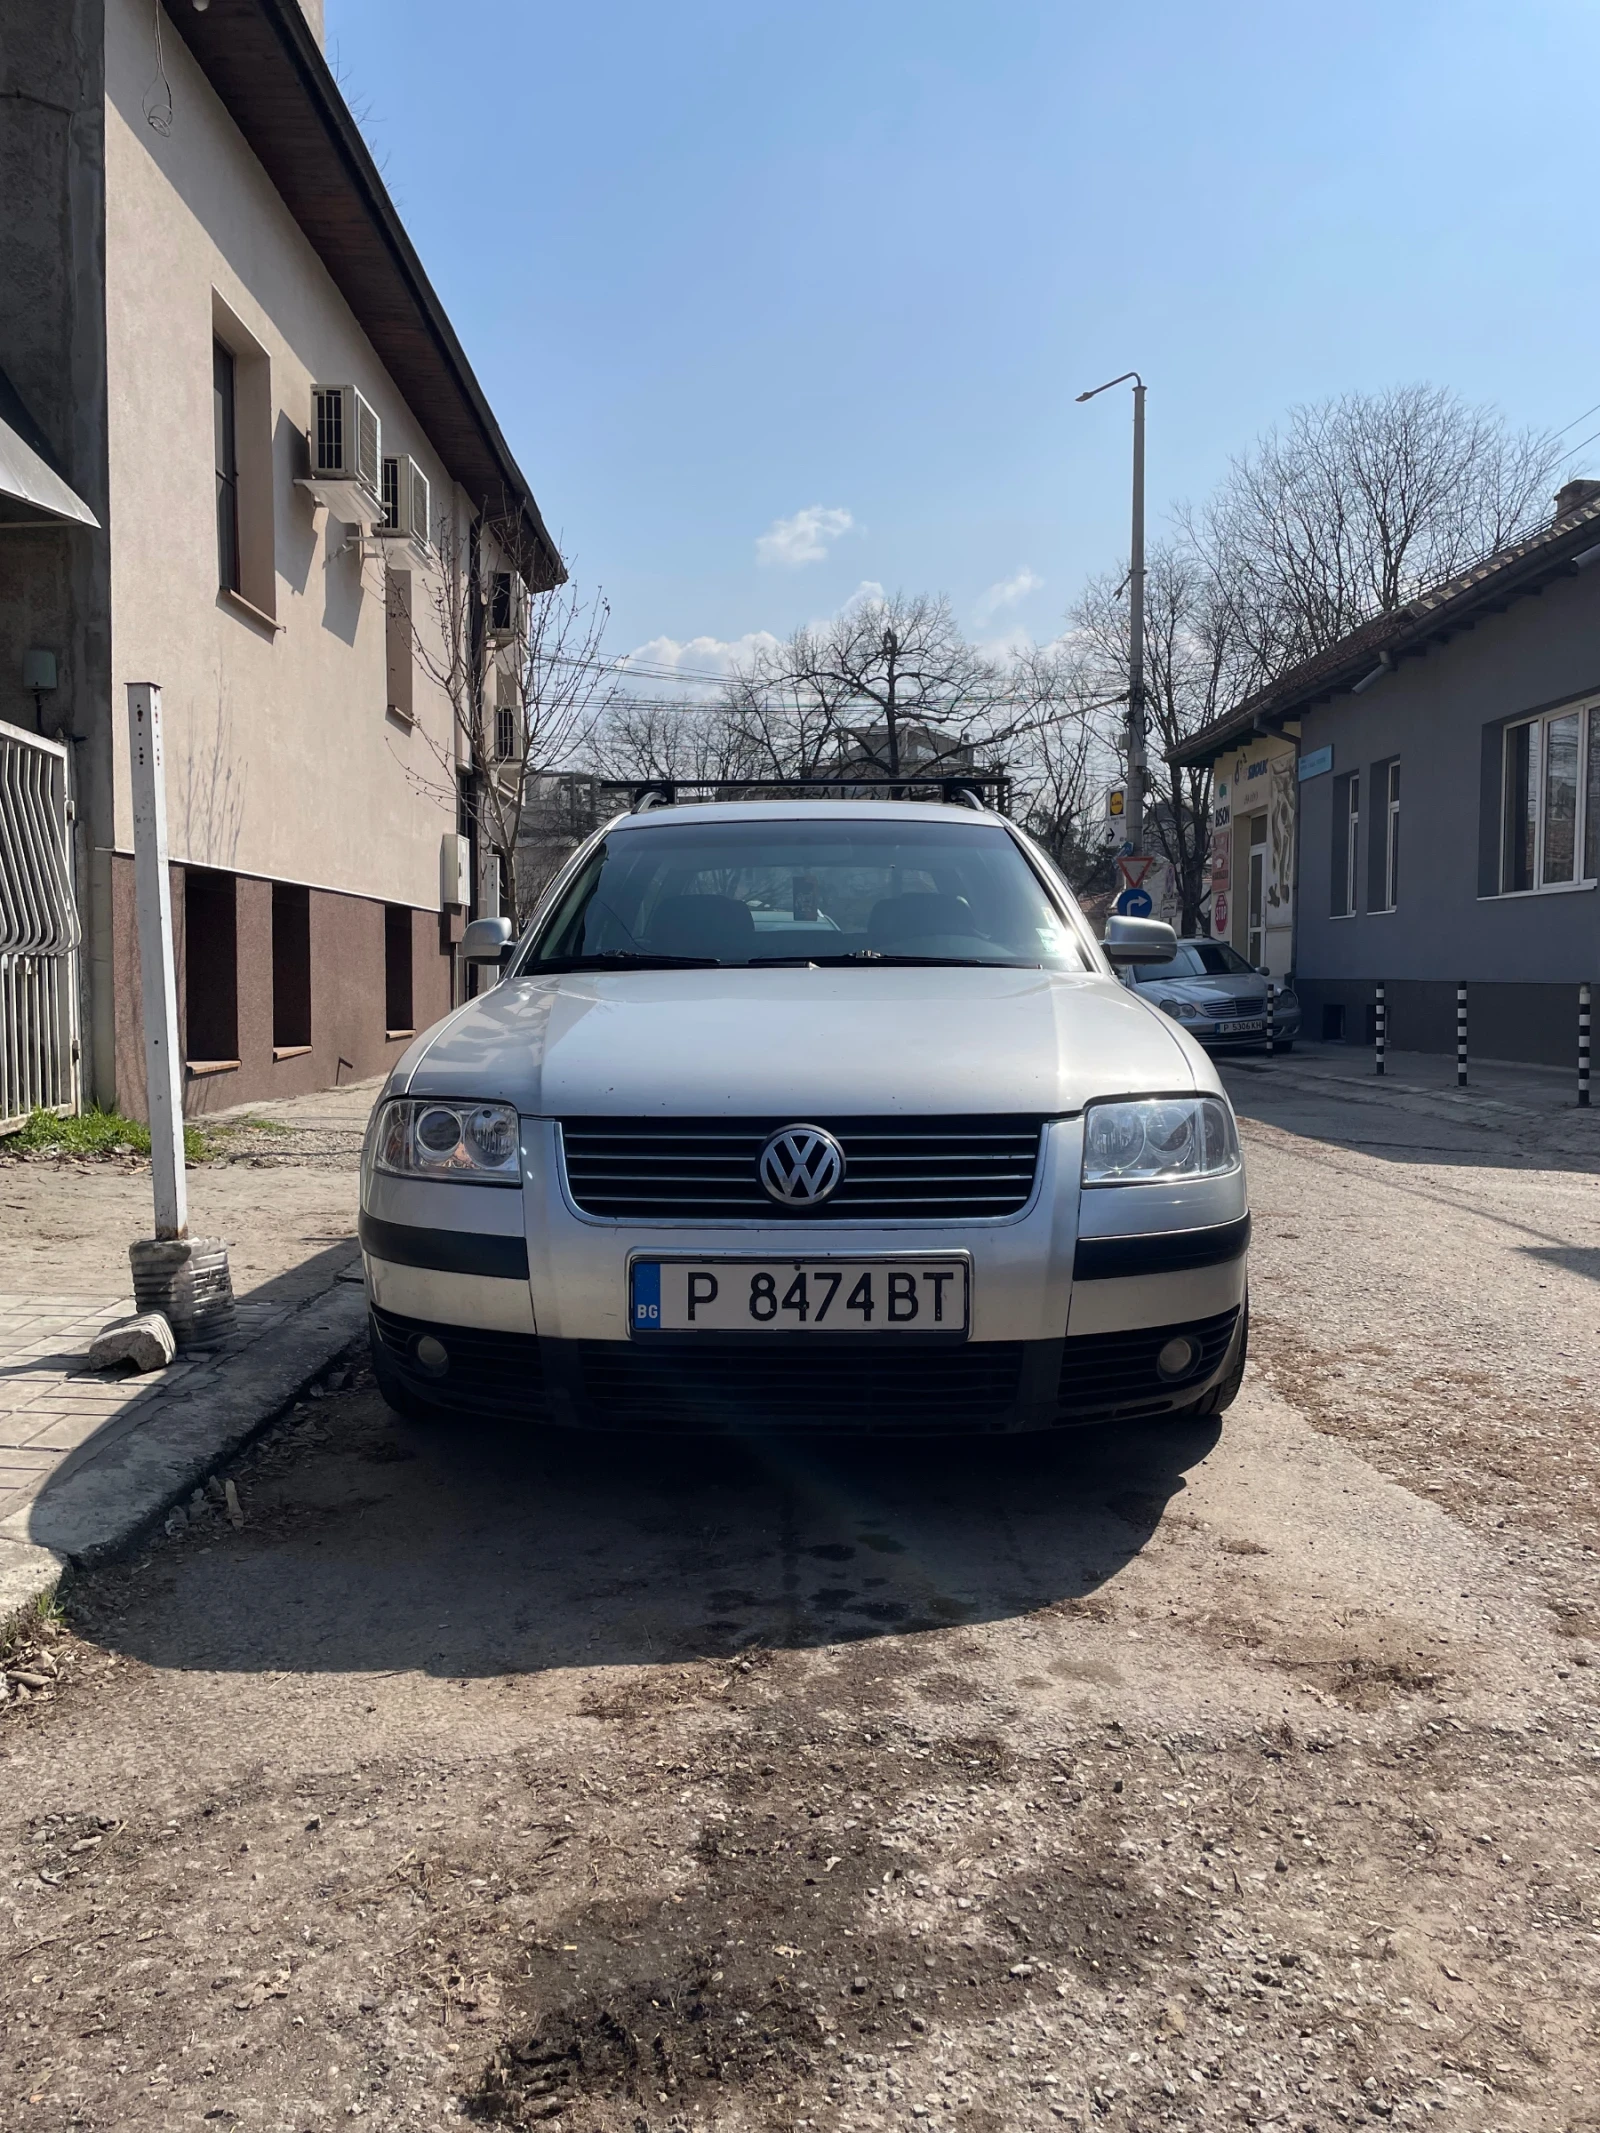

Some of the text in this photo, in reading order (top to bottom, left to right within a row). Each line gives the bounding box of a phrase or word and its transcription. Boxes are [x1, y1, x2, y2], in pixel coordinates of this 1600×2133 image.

[1215, 905, 1226, 921] STOP
[687, 1272, 718, 1321] P
[636, 1304, 658, 1319] BG
